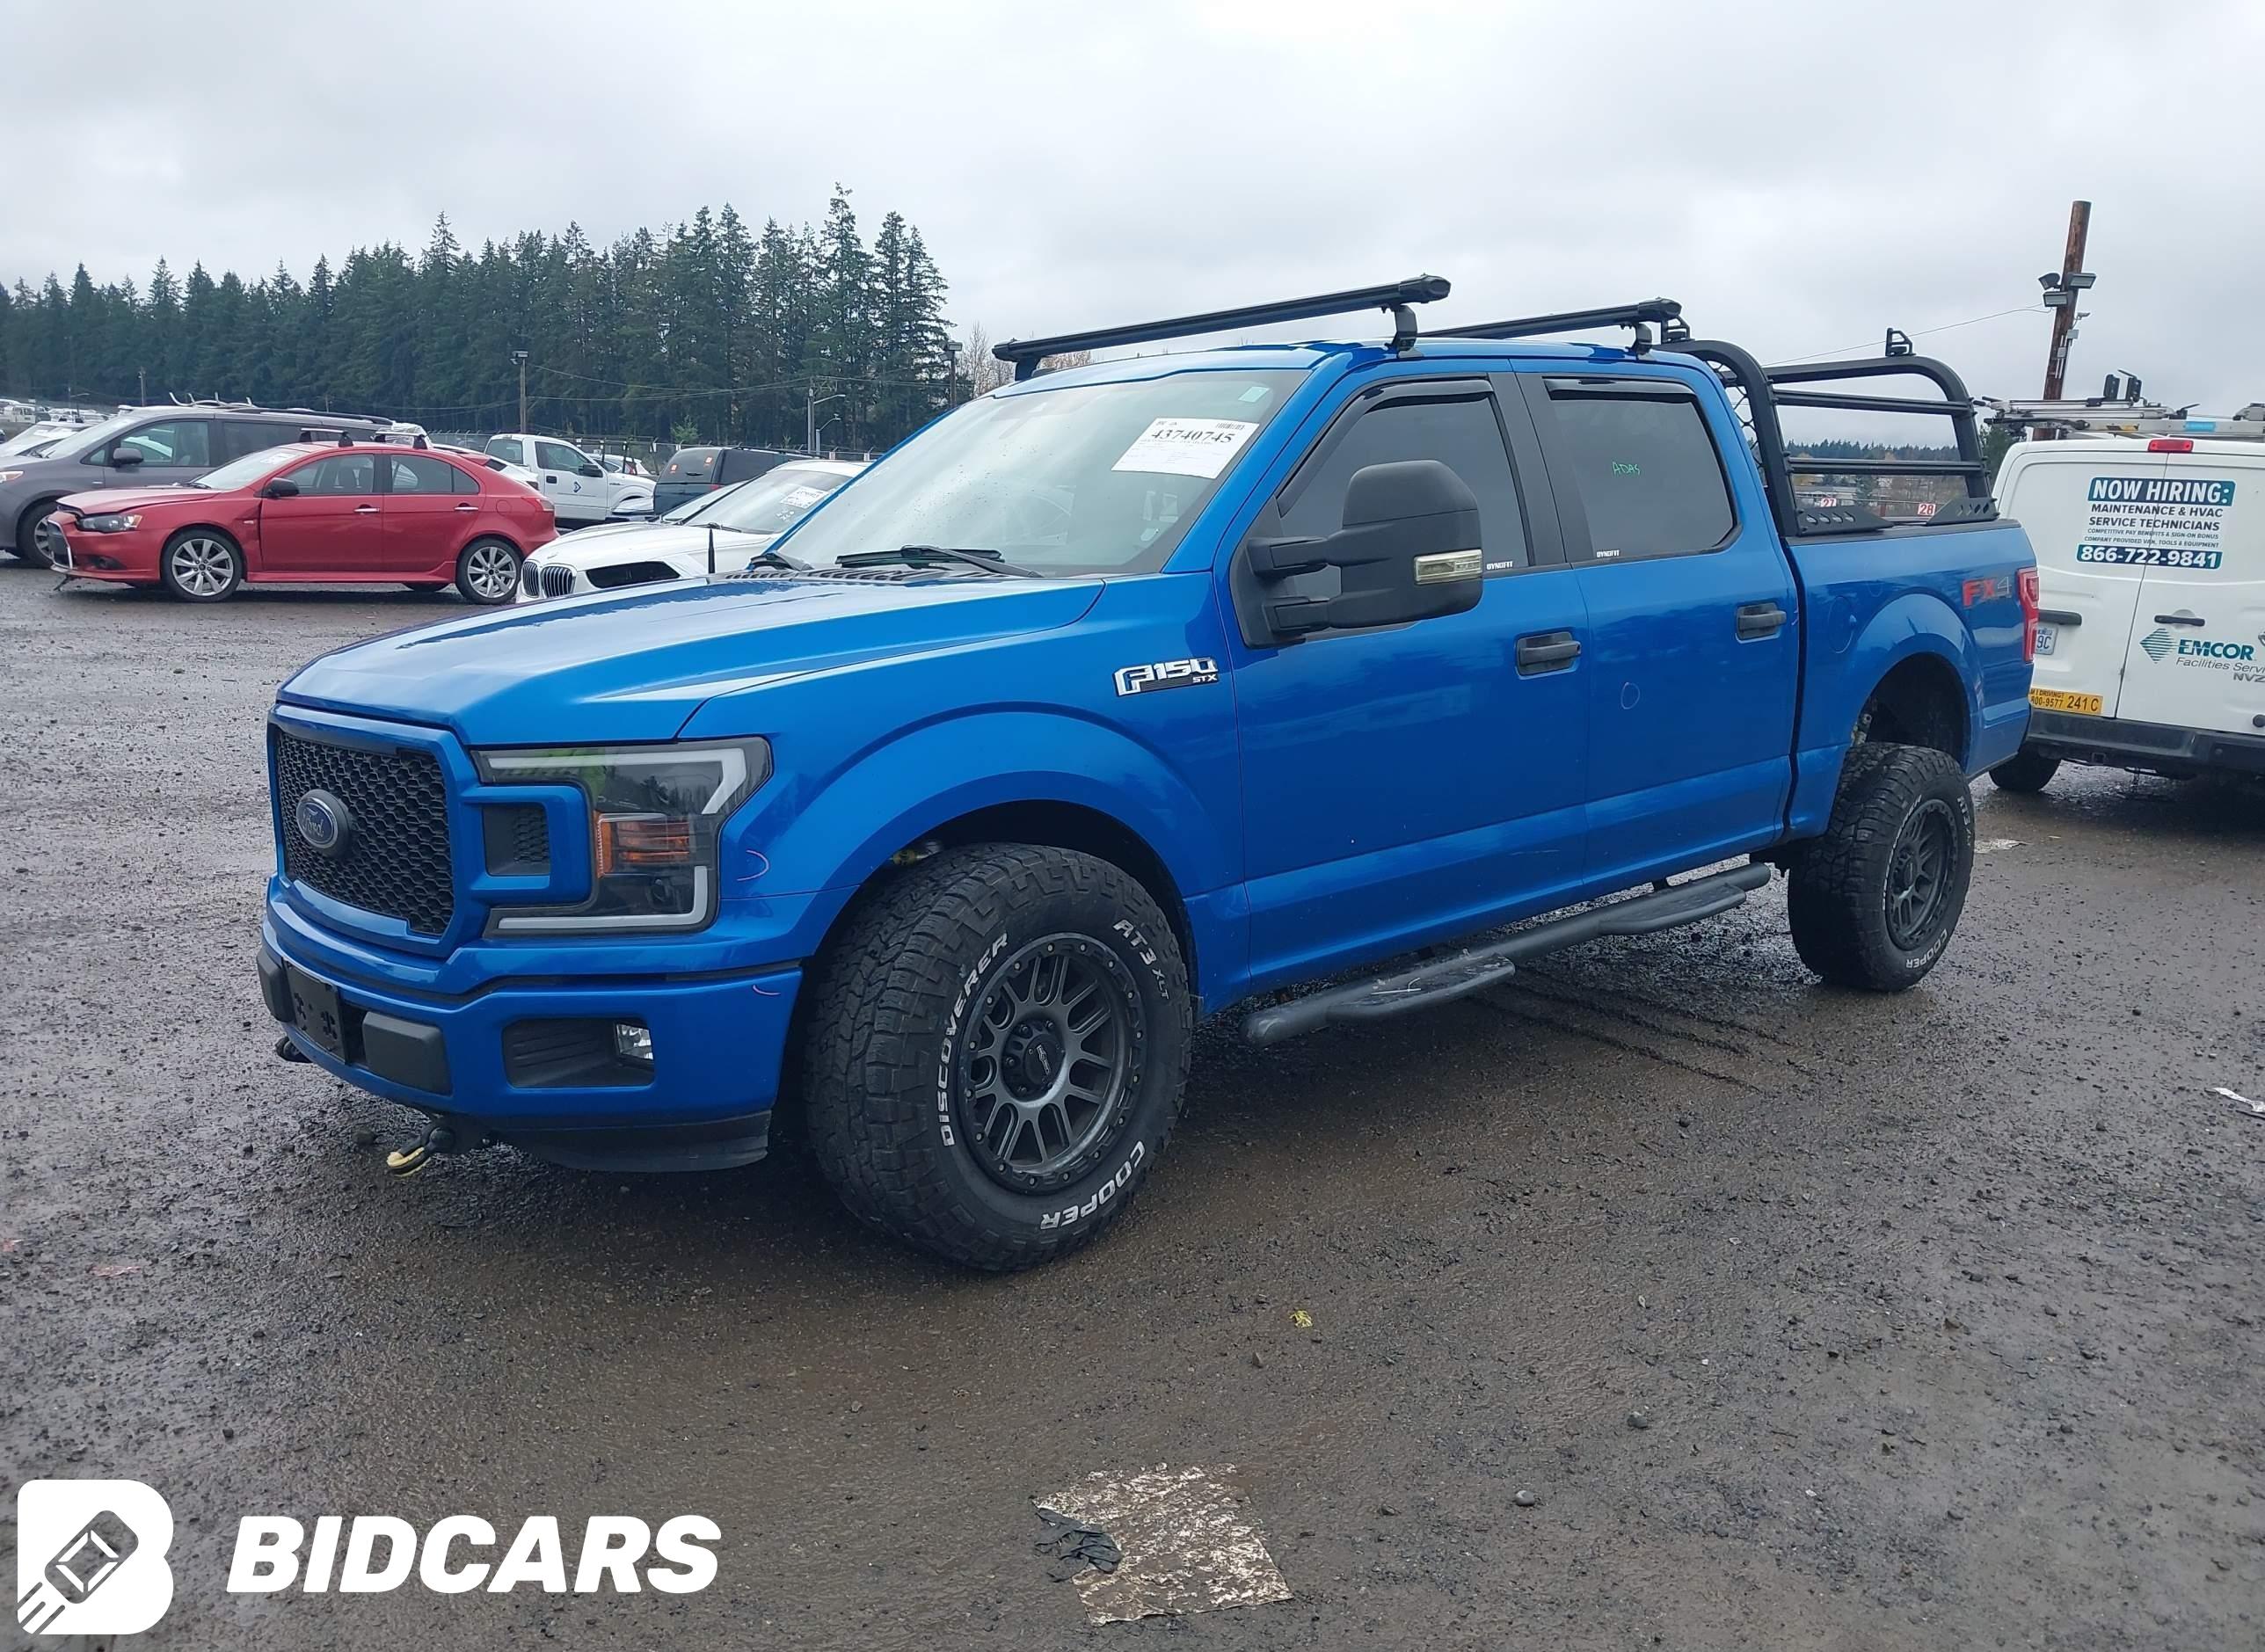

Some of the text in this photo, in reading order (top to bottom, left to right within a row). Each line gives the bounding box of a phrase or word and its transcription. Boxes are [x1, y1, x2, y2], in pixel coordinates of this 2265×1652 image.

[1151, 429, 1235, 443] 43740745
[2093, 479, 2230, 504] NOW HIRING:
[1823, 499, 1835, 507] 27
[1919, 504, 1934, 515] 28
[2091, 504, 2224, 518] MAINTENANCE & HVAC
[2088, 516, 2220, 531] SERVICE TECHNICIANS
[2080, 546, 2217, 568] 866-722-9841
[1963, 577, 2012, 608] FX4
[2178, 638, 2254, 660] EMCOR
[2176, 657, 2231, 670] Facilities
[1192, 673, 1218, 683] STX
[2066, 695, 2100, 712] 241 C
[1112, 919, 1157, 965] AT3
[1905, 928, 1948, 968] COOPER
[937, 932, 1009, 1146] DISCOVERER
[1040, 1140, 1146, 1230] COOPER
